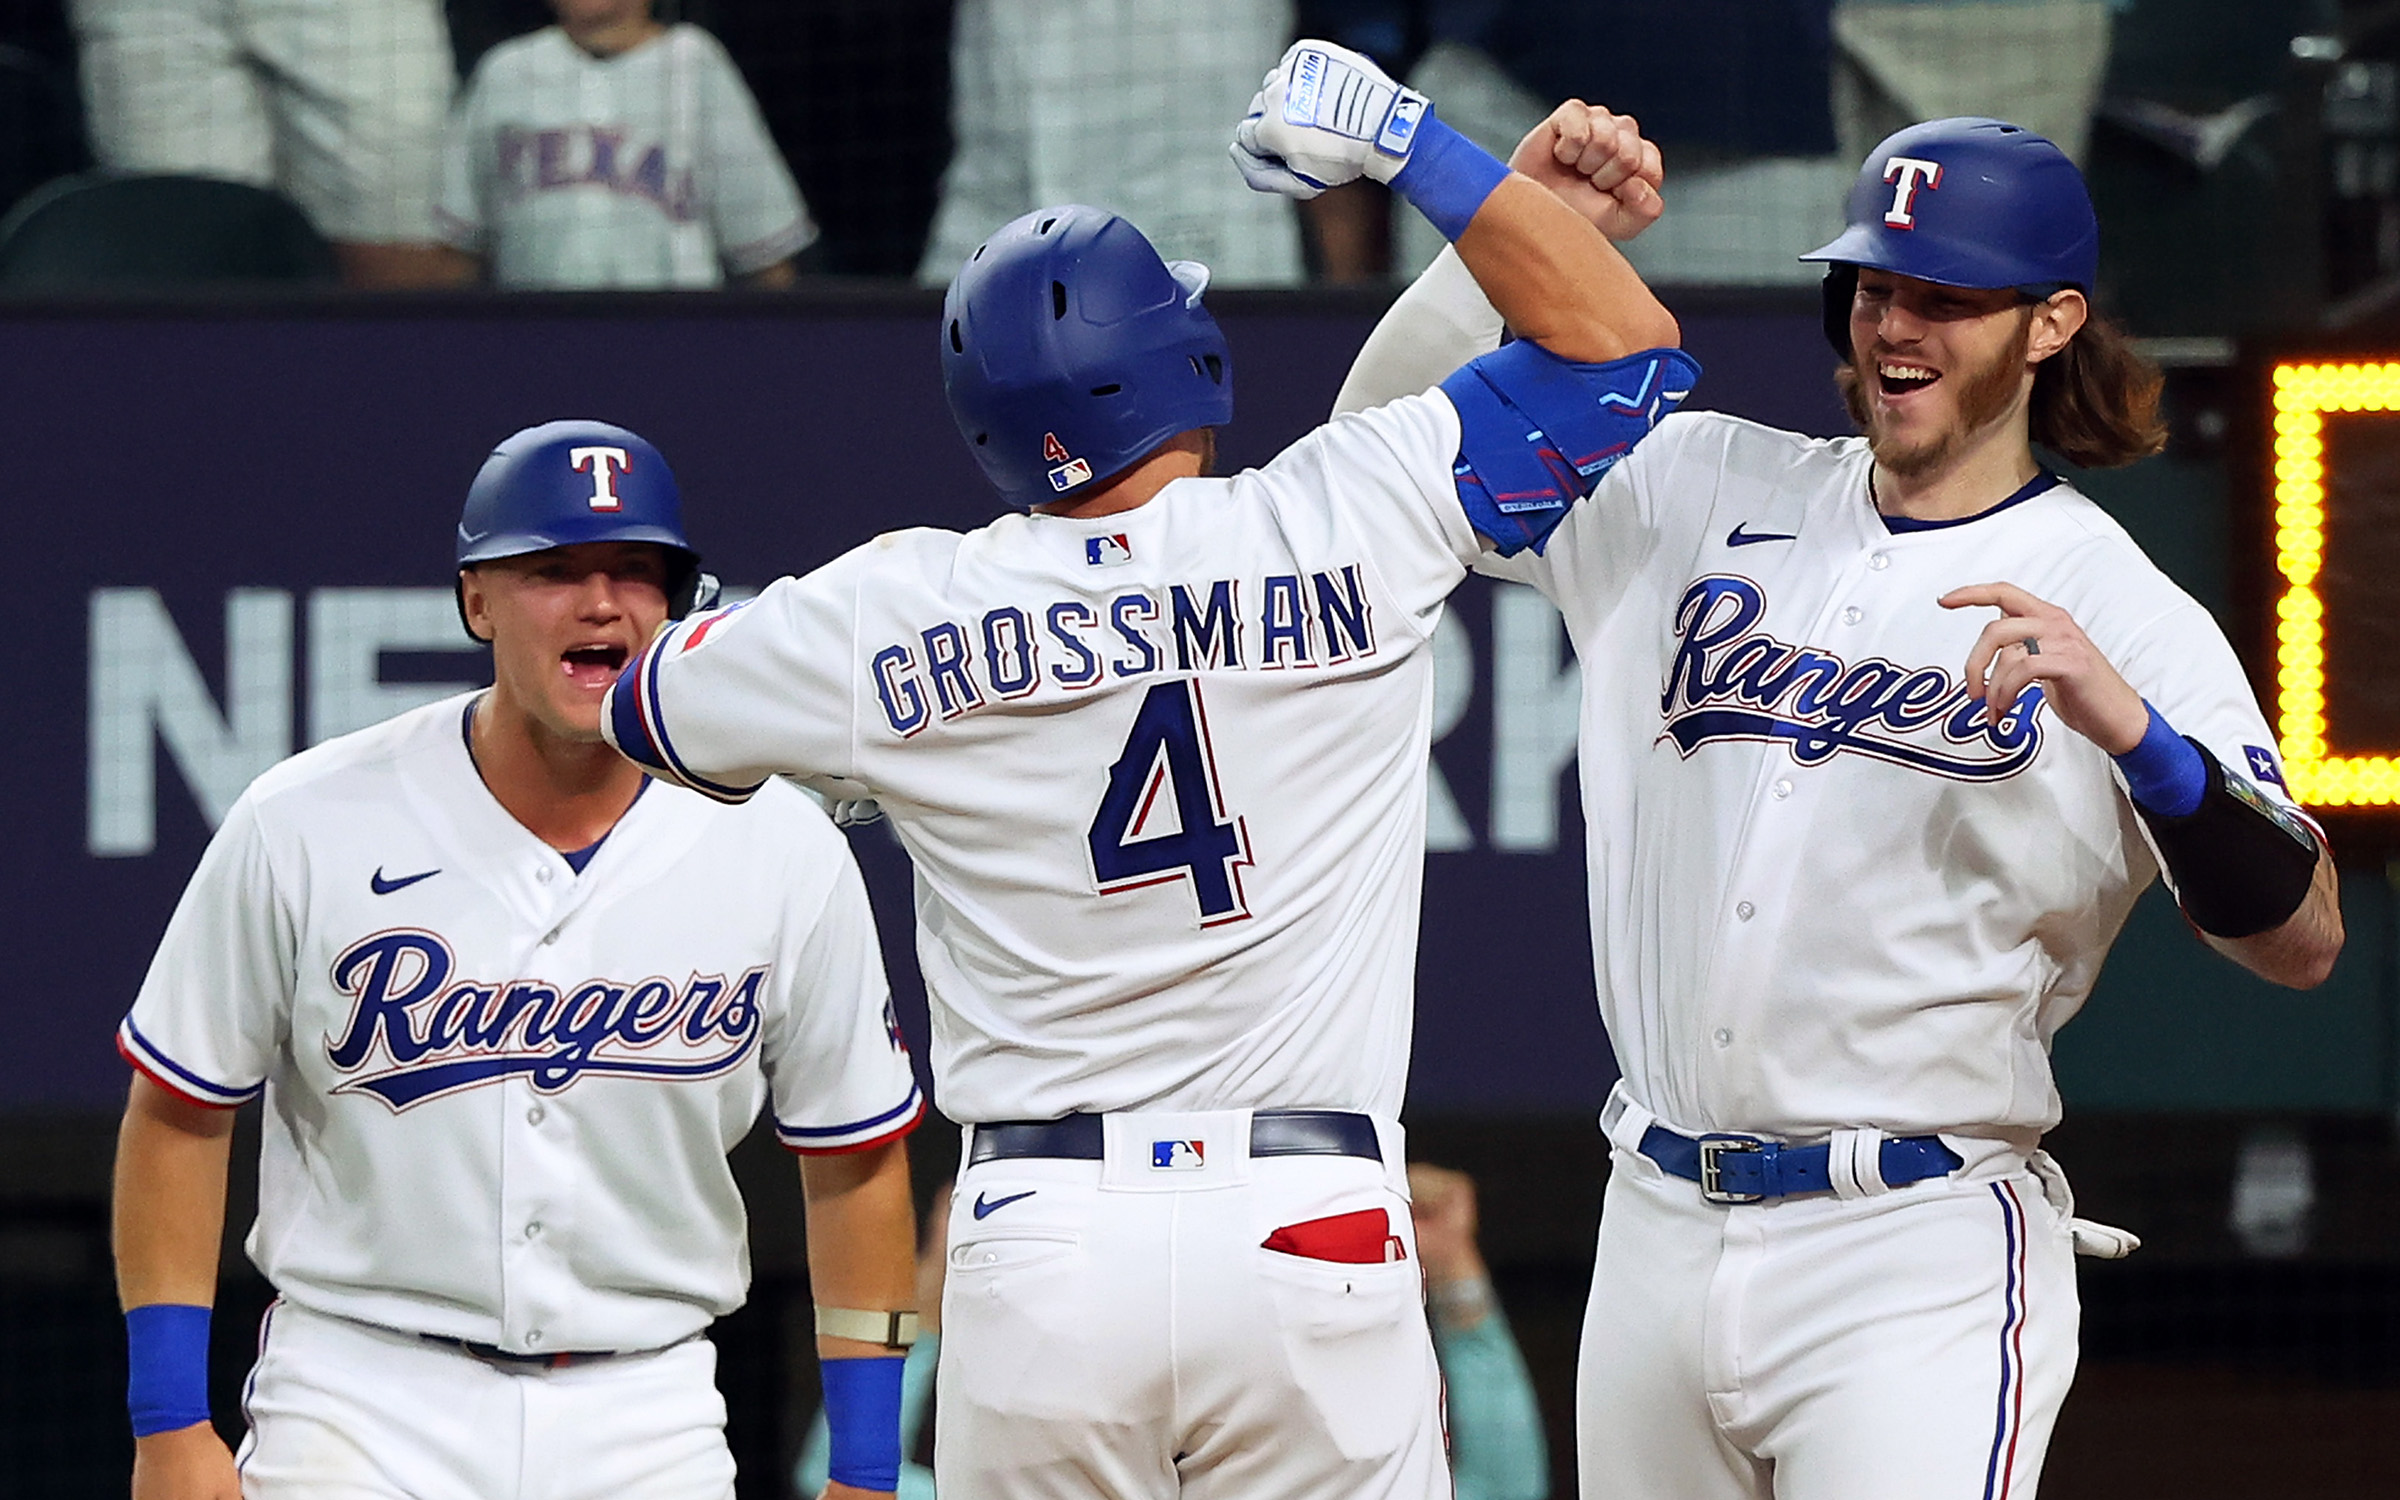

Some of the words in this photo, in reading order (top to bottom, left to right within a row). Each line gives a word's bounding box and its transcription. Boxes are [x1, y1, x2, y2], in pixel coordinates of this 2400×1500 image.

[1884, 156, 1944, 231] T
[569, 446, 633, 513] T
[1043, 432, 1070, 462] 4
[871, 562, 1377, 739] GROSSMAN
[1086, 678, 1255, 930] 4
[324, 927, 771, 1114] Rangers
